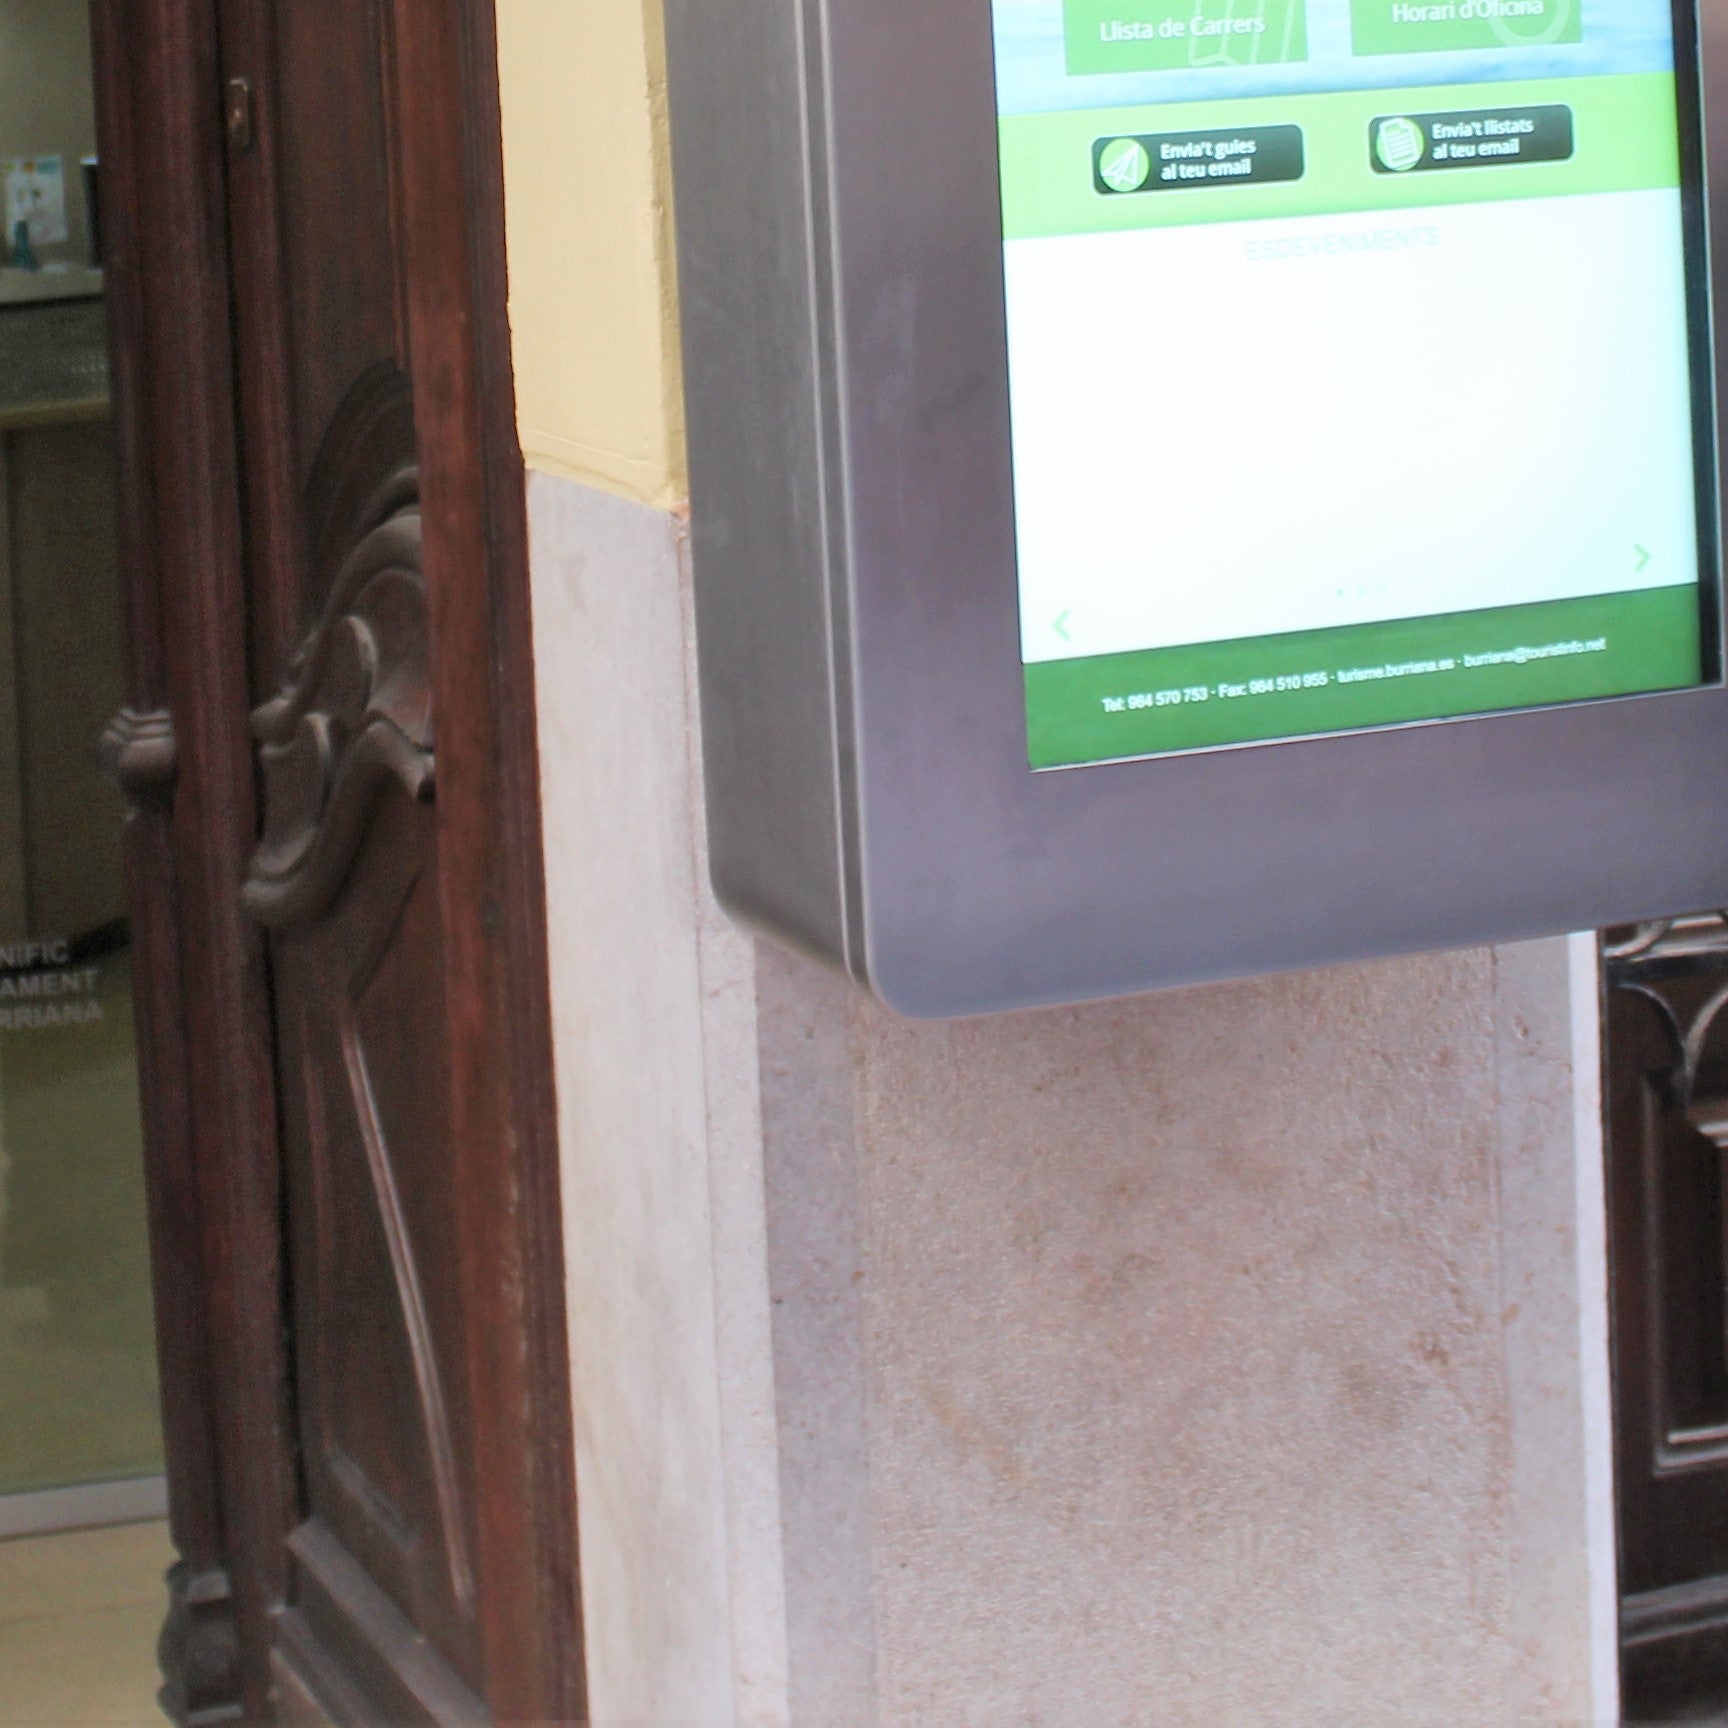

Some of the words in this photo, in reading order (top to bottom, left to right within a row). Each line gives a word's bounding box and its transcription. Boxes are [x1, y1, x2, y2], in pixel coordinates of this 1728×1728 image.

[1391, 0, 1456, 23] Horari
[1099, 19, 1154, 42] Llista
[1158, 17, 1186, 39] de
[1189, 14, 1267, 37] Carrers
[1431, 121, 1483, 140] Envia't
[1484, 117, 1535, 136] llistats
[1159, 141, 1212, 161] Envia't
[1214, 139, 1257, 160] guies
[1432, 144, 1448, 161] al
[1449, 141, 1476, 159] teu
[1477, 137, 1520, 157] email
[1159, 164, 1177, 181] al
[1178, 162, 1206, 180] teu
[1207, 157, 1252, 177] email
[1245, 225, 1440, 263] ESDEVENIMENTS
[1154, 690, 1181, 706] 570
[1182, 686, 1209, 703] 753
[1275, 675, 1302, 691] 510
